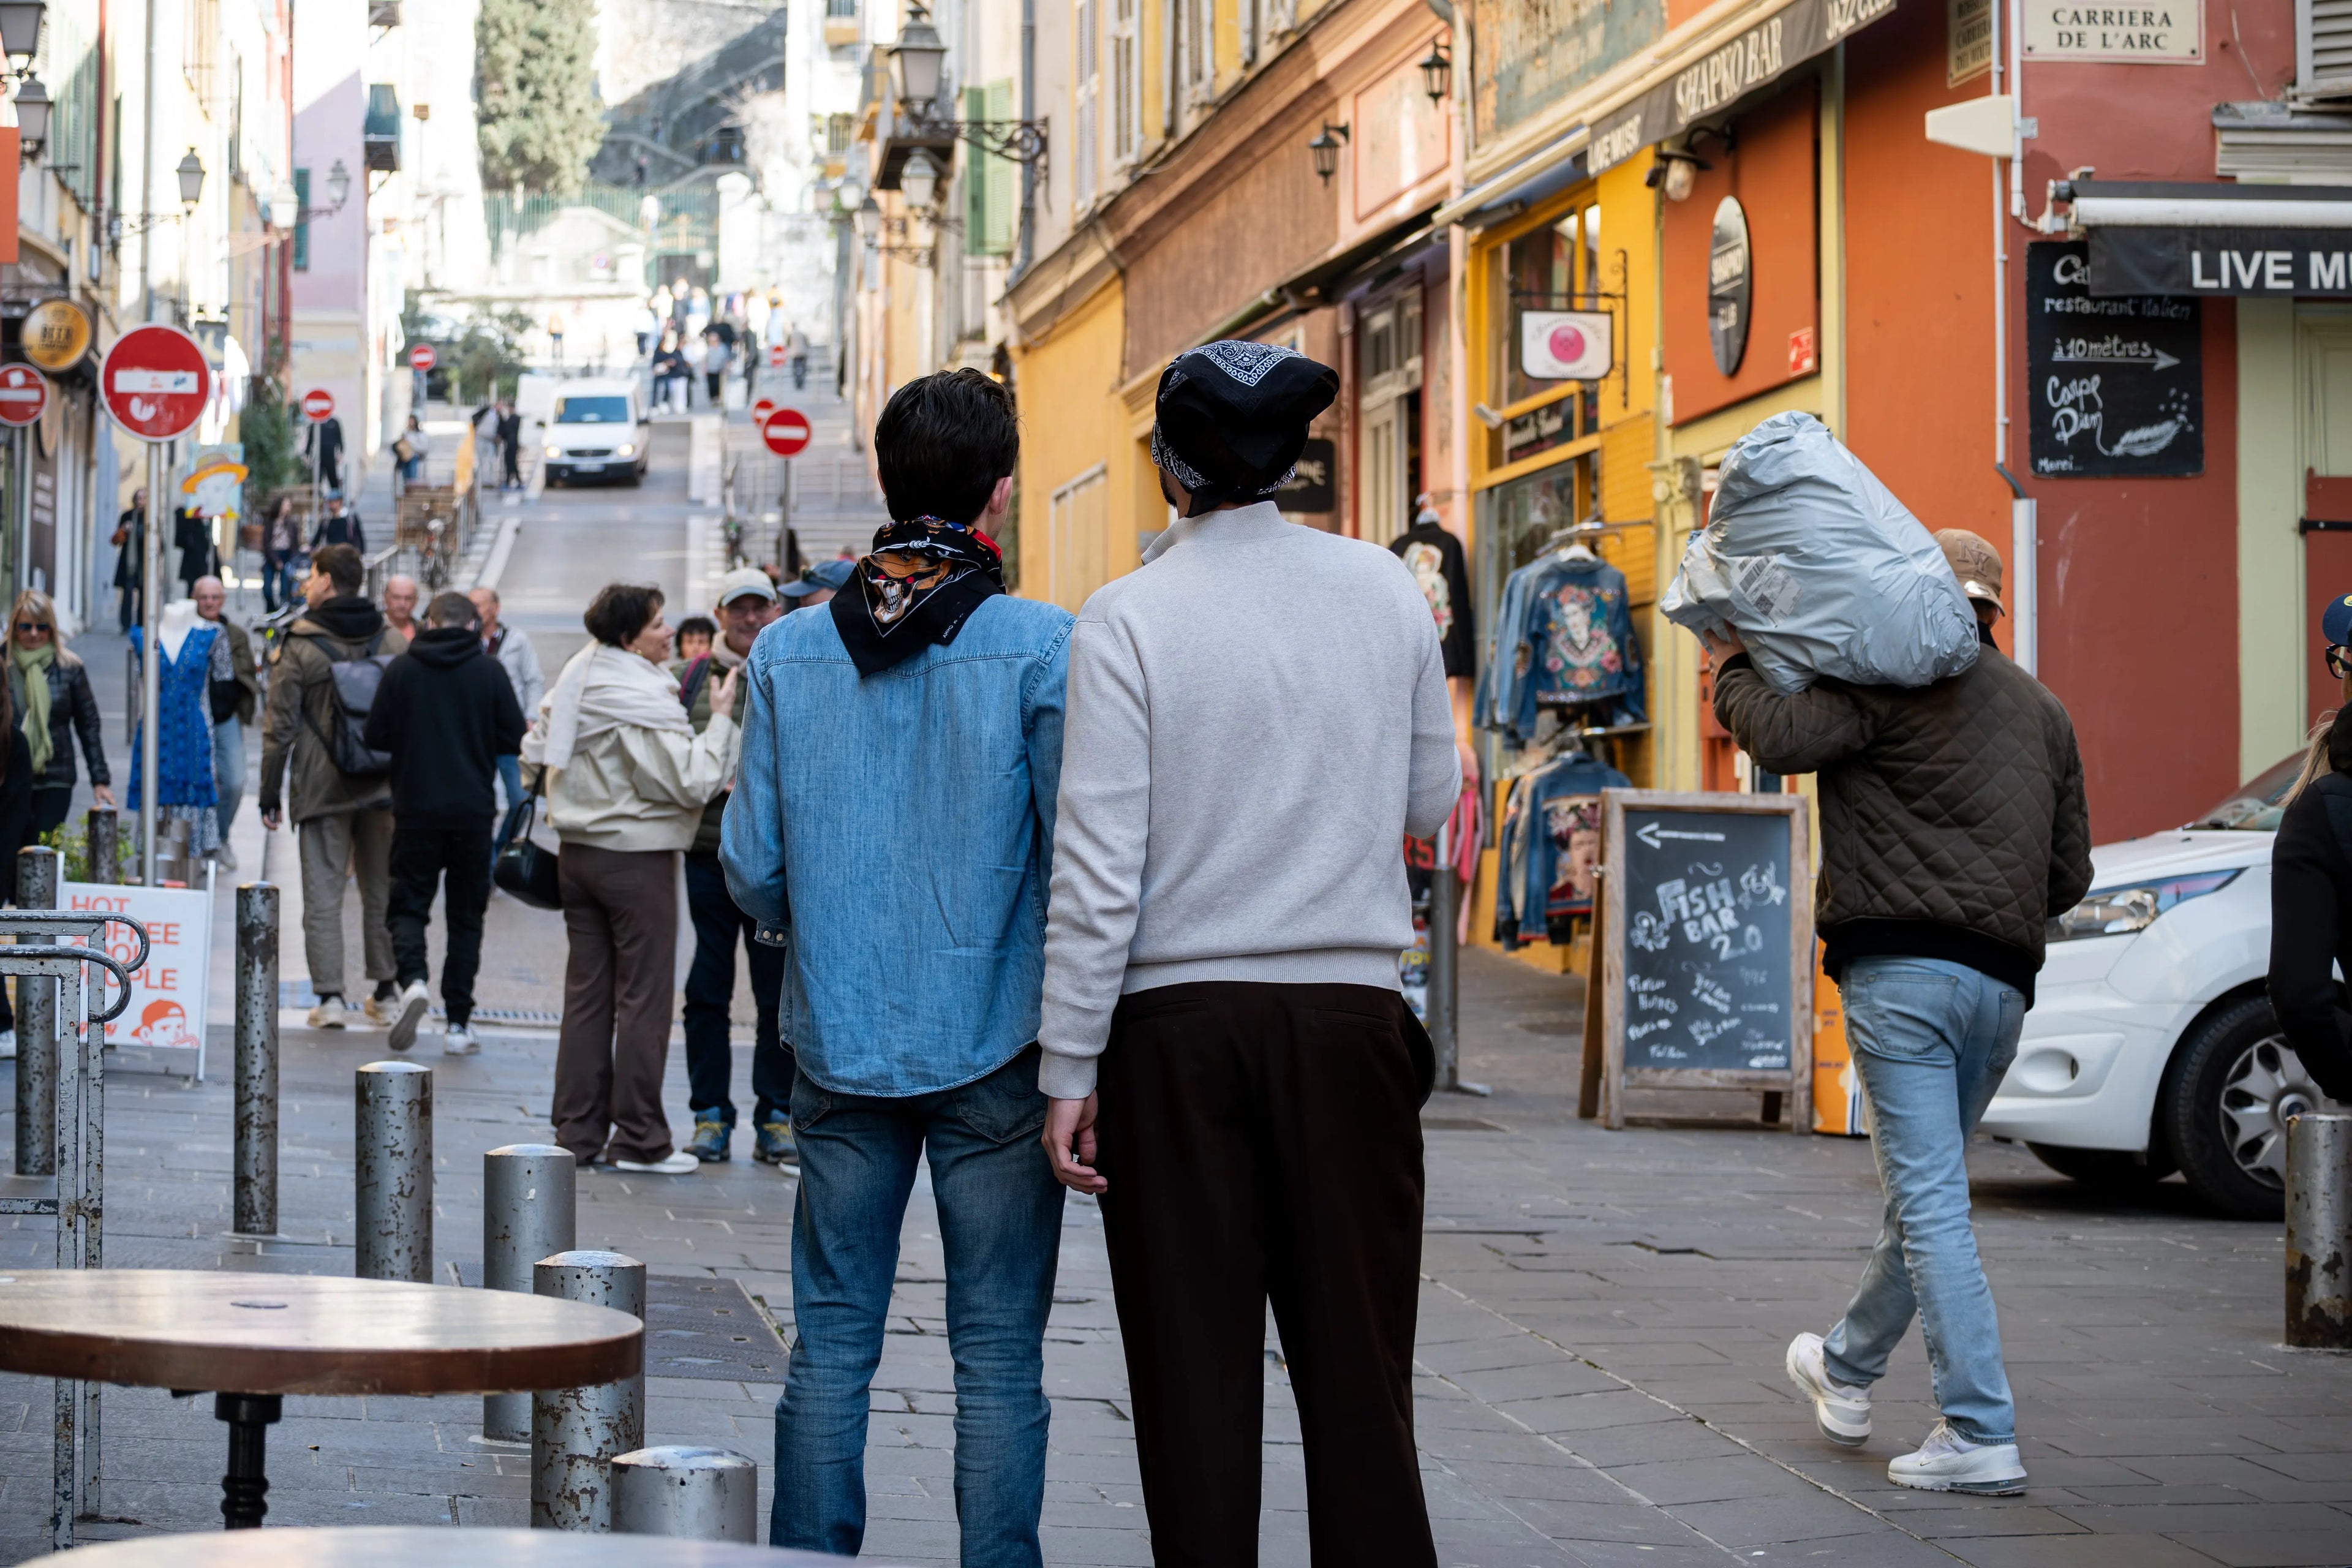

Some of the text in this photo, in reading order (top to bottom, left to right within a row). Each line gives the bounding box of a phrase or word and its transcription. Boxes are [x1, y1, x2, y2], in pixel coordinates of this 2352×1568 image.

[2052, 7, 2173, 28] CARRIERA
[2057, 31, 2169, 50] DE L'ARC
[1675, 39, 1744, 125] SHAPKO
[1744, 17, 1784, 86] BAR
[2191, 250, 2352, 290] LIVE M
[1717, 302, 1738, 332] CLUB
[2044, 296, 2136, 315] restaurant
[2046, 374, 2103, 412] Carpe
[1956, 539, 1992, 578] NY
[1656, 877, 1736, 924] FISH
[1684, 907, 1740, 943] BAR
[1709, 924, 1763, 962] 2.0
